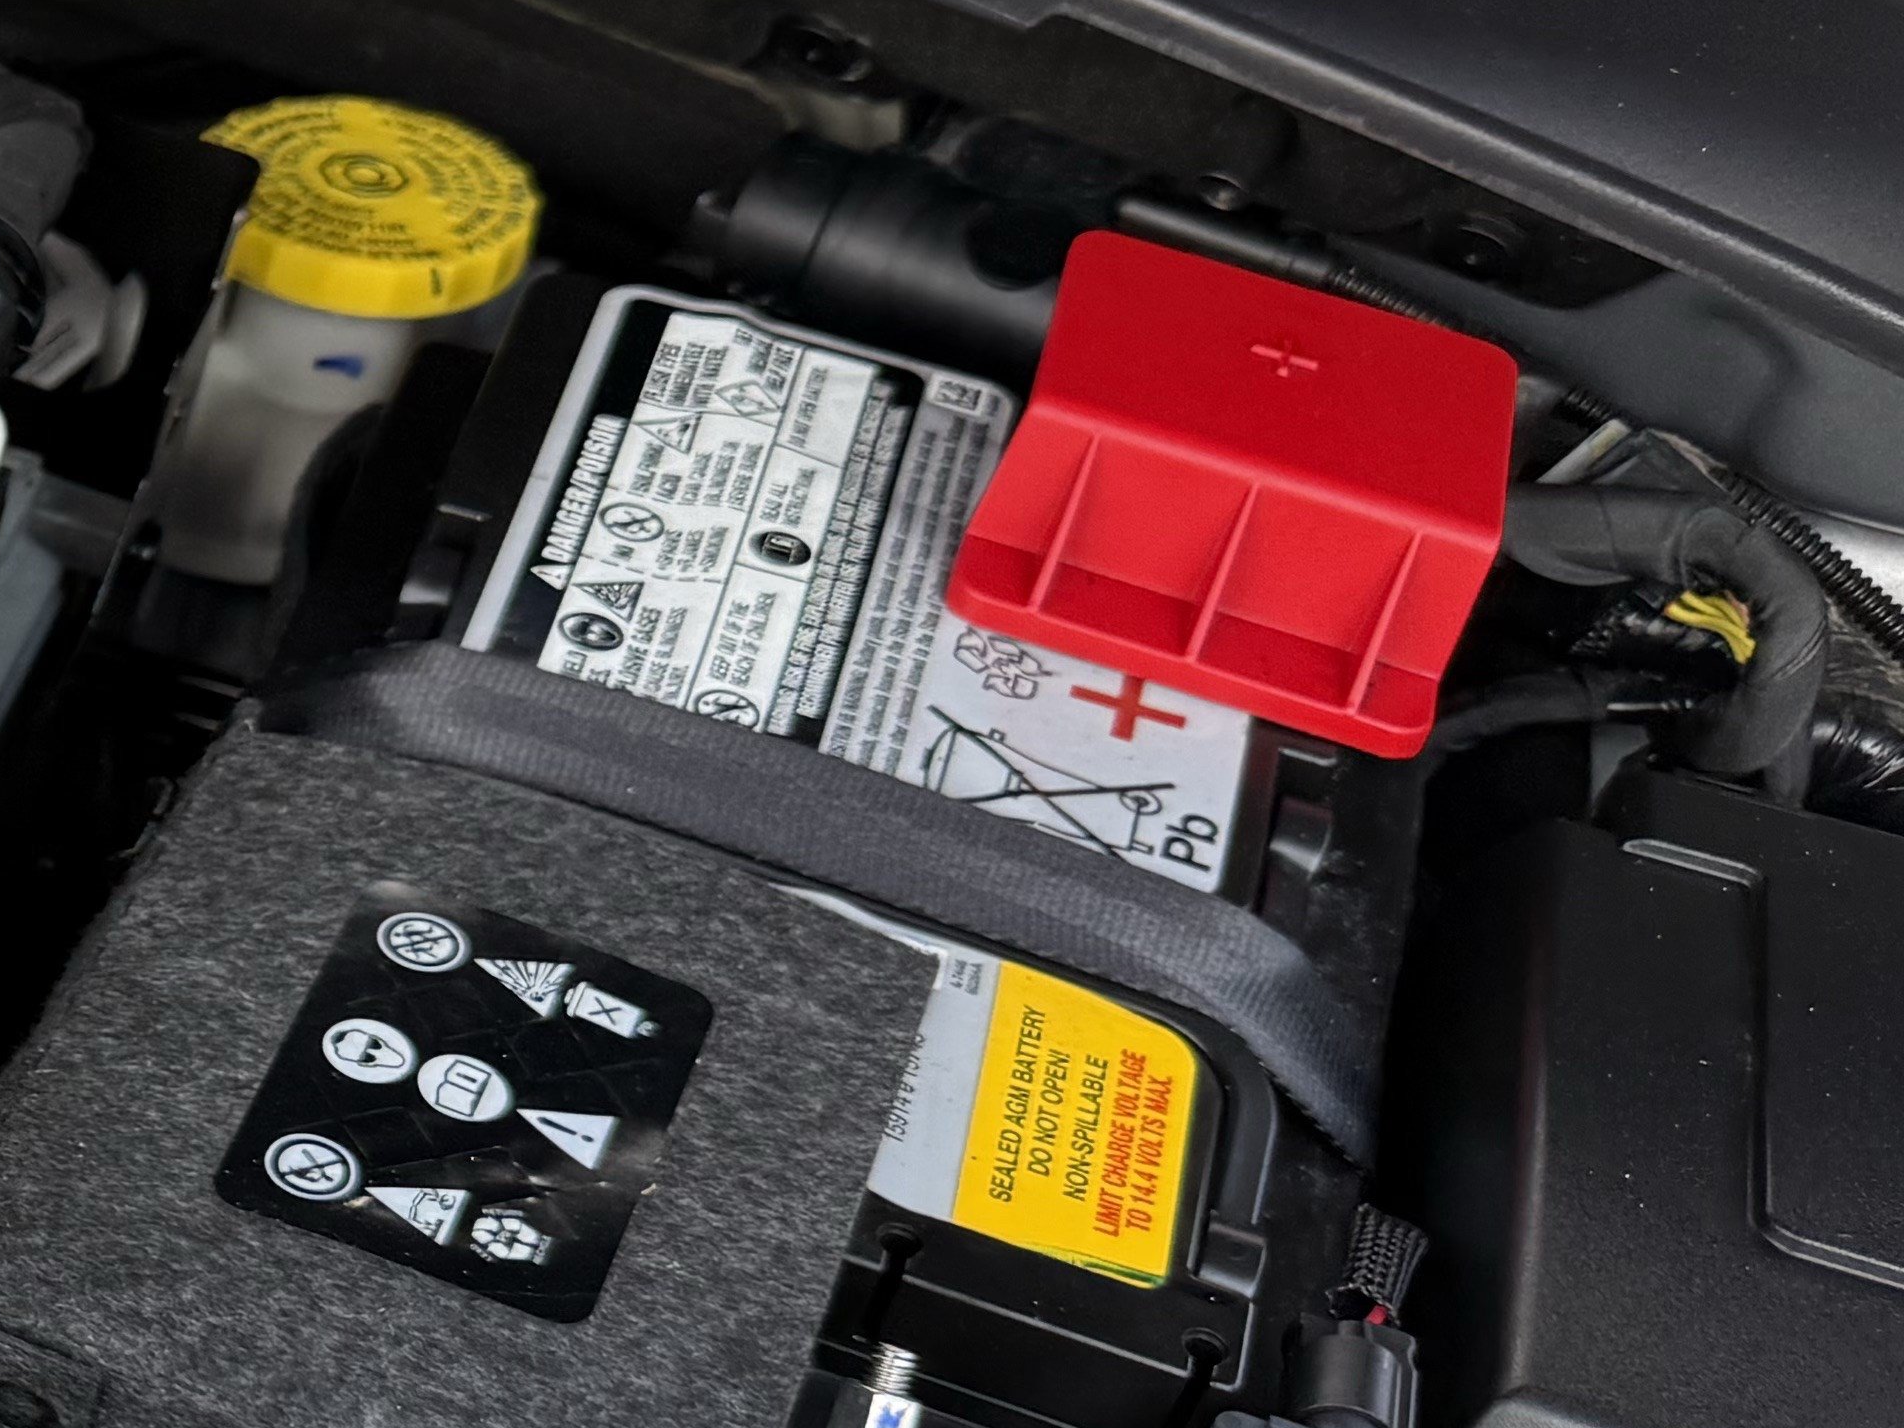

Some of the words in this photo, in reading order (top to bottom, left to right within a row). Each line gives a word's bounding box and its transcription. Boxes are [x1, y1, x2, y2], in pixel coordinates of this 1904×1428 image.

[543, 417, 621, 561] DANGER/POISON
[1160, 814, 1219, 872] Pb
[1012, 1005, 1044, 1083] BATTERY
[1040, 1049, 1069, 1104] OPEN!
[1113, 1049, 1145, 1118] VOLTAGE
[1004, 1085, 1030, 1128] AGM
[1032, 1105, 1060, 1145] NOT
[1064, 1055, 1107, 1200] NON-SPILLABLE
[989, 1129, 1021, 1201] SEALED
[1027, 1147, 1052, 1176] DO
[1102, 1120, 1134, 1187] CHARGE
[1135, 1115, 1165, 1166] VOLTS
[1094, 1187, 1123, 1236] LIMIT
[1130, 1169, 1157, 1205] 14.4
[1125, 1208, 1152, 1231] TO
